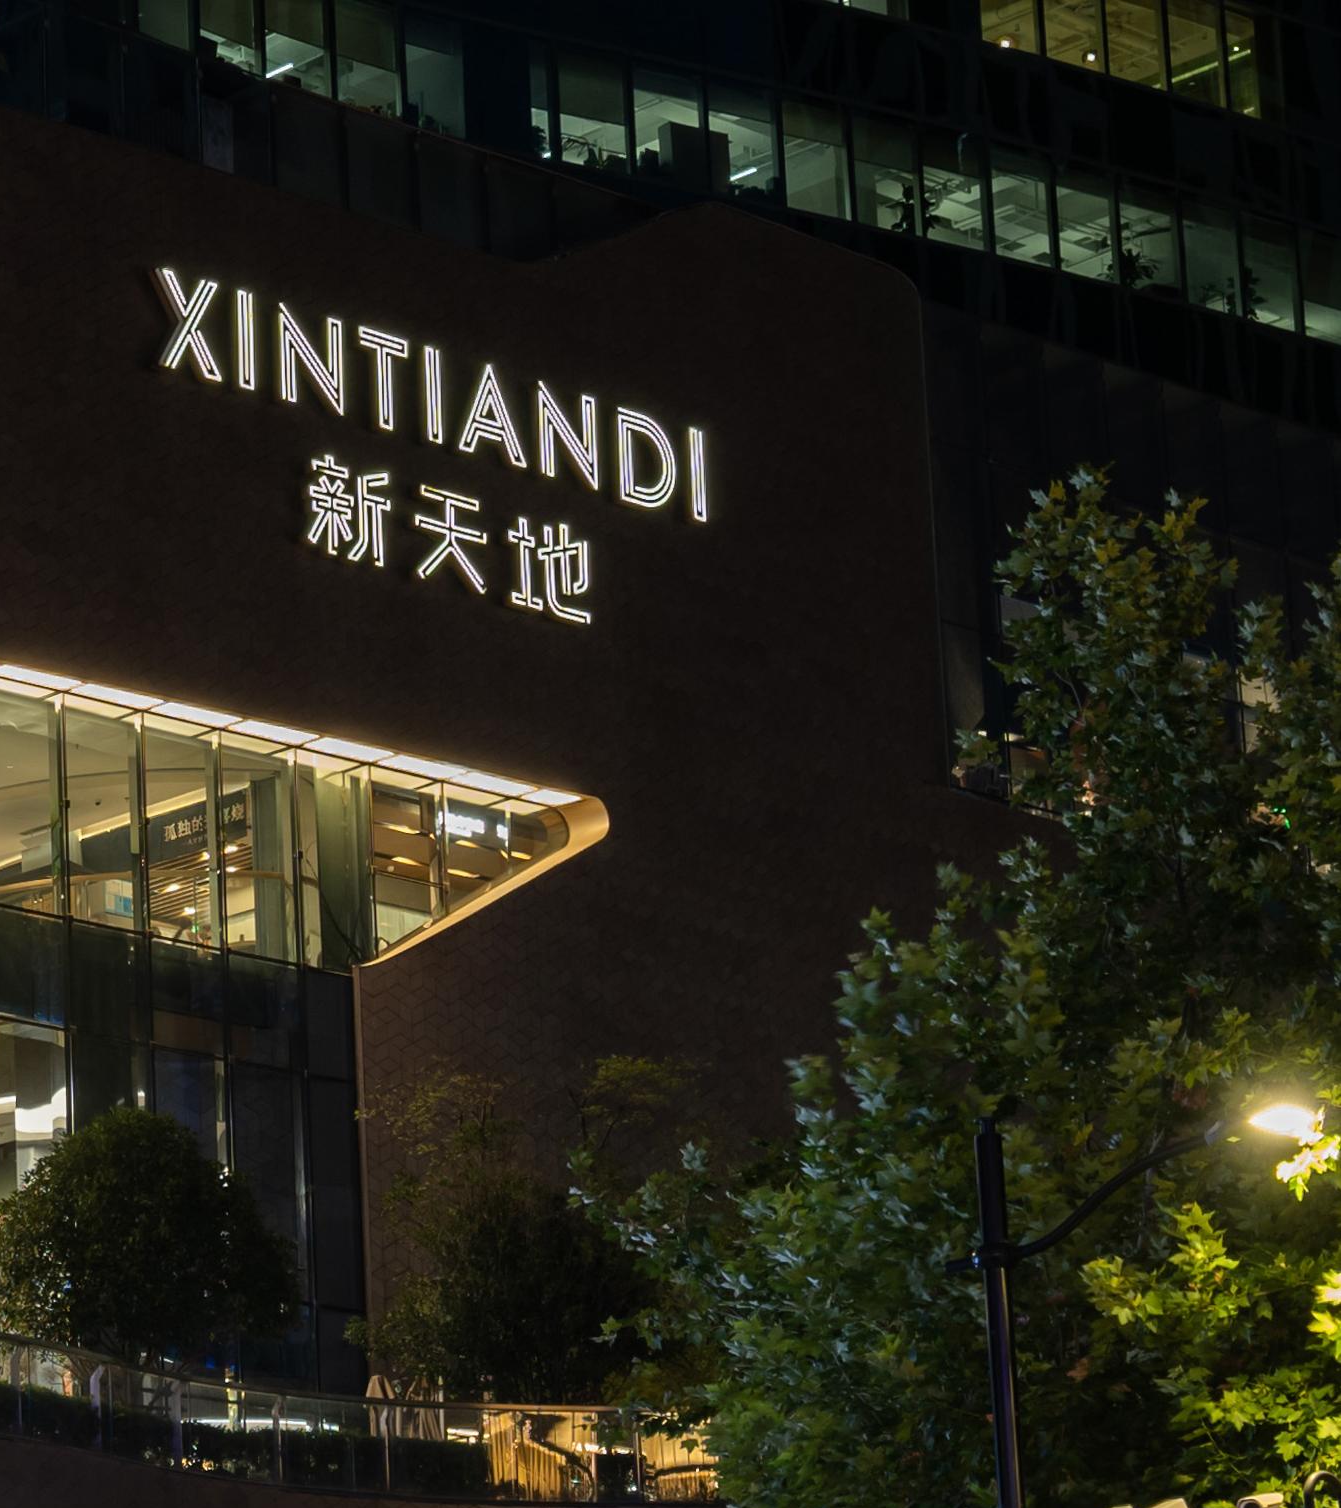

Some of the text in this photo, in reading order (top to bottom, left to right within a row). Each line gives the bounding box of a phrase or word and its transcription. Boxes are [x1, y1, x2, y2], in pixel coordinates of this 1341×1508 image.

[154, 267, 707, 523] XINTIANDI
[307, 455, 592, 624] 新天地
